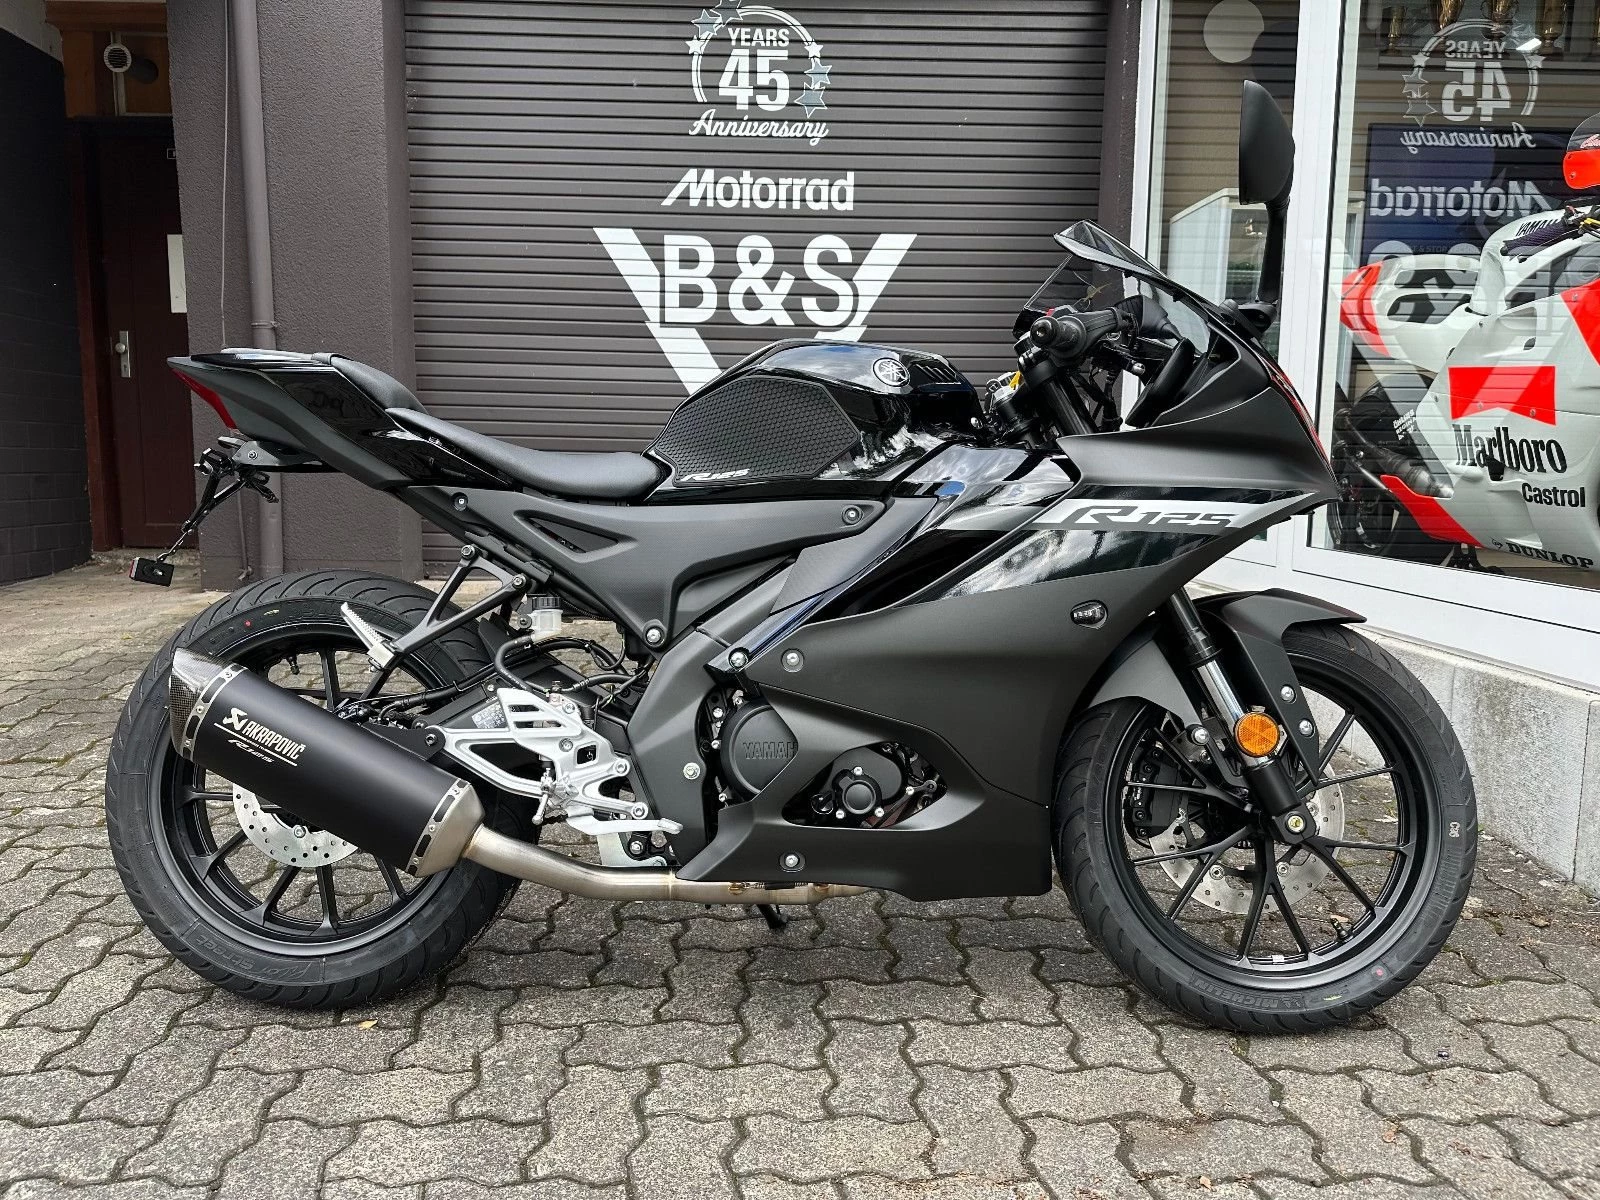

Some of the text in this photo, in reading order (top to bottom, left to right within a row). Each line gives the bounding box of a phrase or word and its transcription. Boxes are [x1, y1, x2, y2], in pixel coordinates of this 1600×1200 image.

[727, 28, 790, 47] YEARS
[718, 49, 790, 112] 45
[689, 108, 829, 146] Anniversary
[661, 168, 855, 211] Motorrad
[663, 234, 853, 327] B & S
[1452, 424, 1568, 474] Marlboro
[1521, 482, 1586, 508] Castrol
[1506, 542, 1594, 569] DUNLOP
